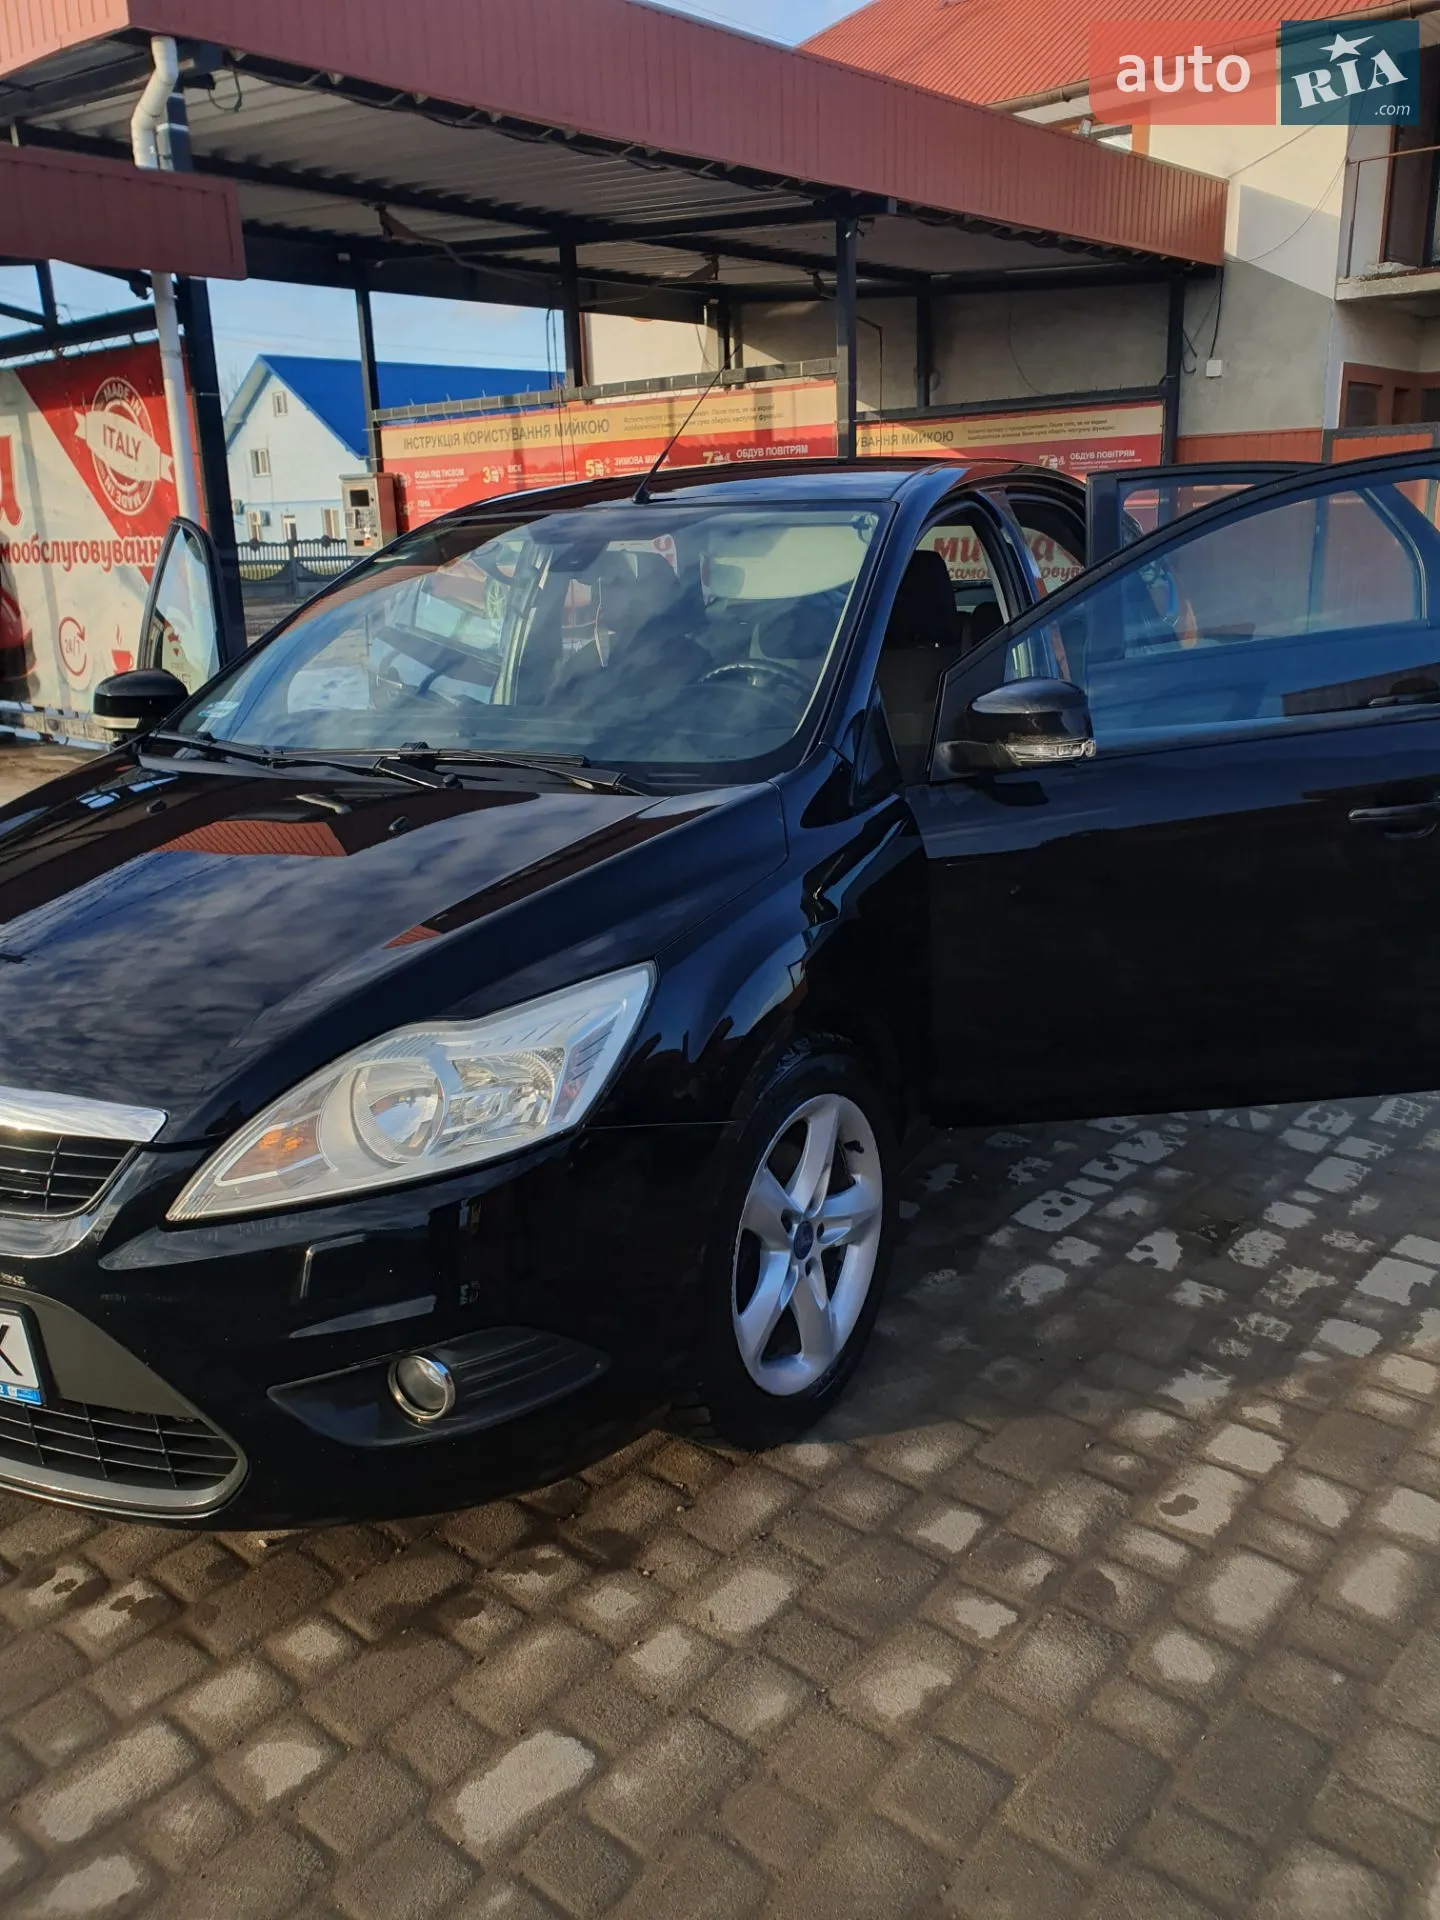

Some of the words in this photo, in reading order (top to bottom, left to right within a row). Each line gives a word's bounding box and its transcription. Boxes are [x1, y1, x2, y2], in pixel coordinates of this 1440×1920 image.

[103, 381, 131, 403] MADE
[102, 423, 142, 462] ITALY
[403, 432, 461, 451] ІНСТРУКЦІЯ
[462, 425, 551, 446] КОРИСТУВАННЯ
[554, 417, 610, 438] МИЙКОЮ
[902, 430, 954, 446] МИЙКОЮ
[736, 448, 764, 460] ОБДУВ
[765, 444, 809, 457] ПОВІТРЯМ
[1070, 452, 1096, 461] ОБДУВ
[1096, 449, 1136, 459] ПОВІТРЯМ
[585, 459, 595, 477] 5
